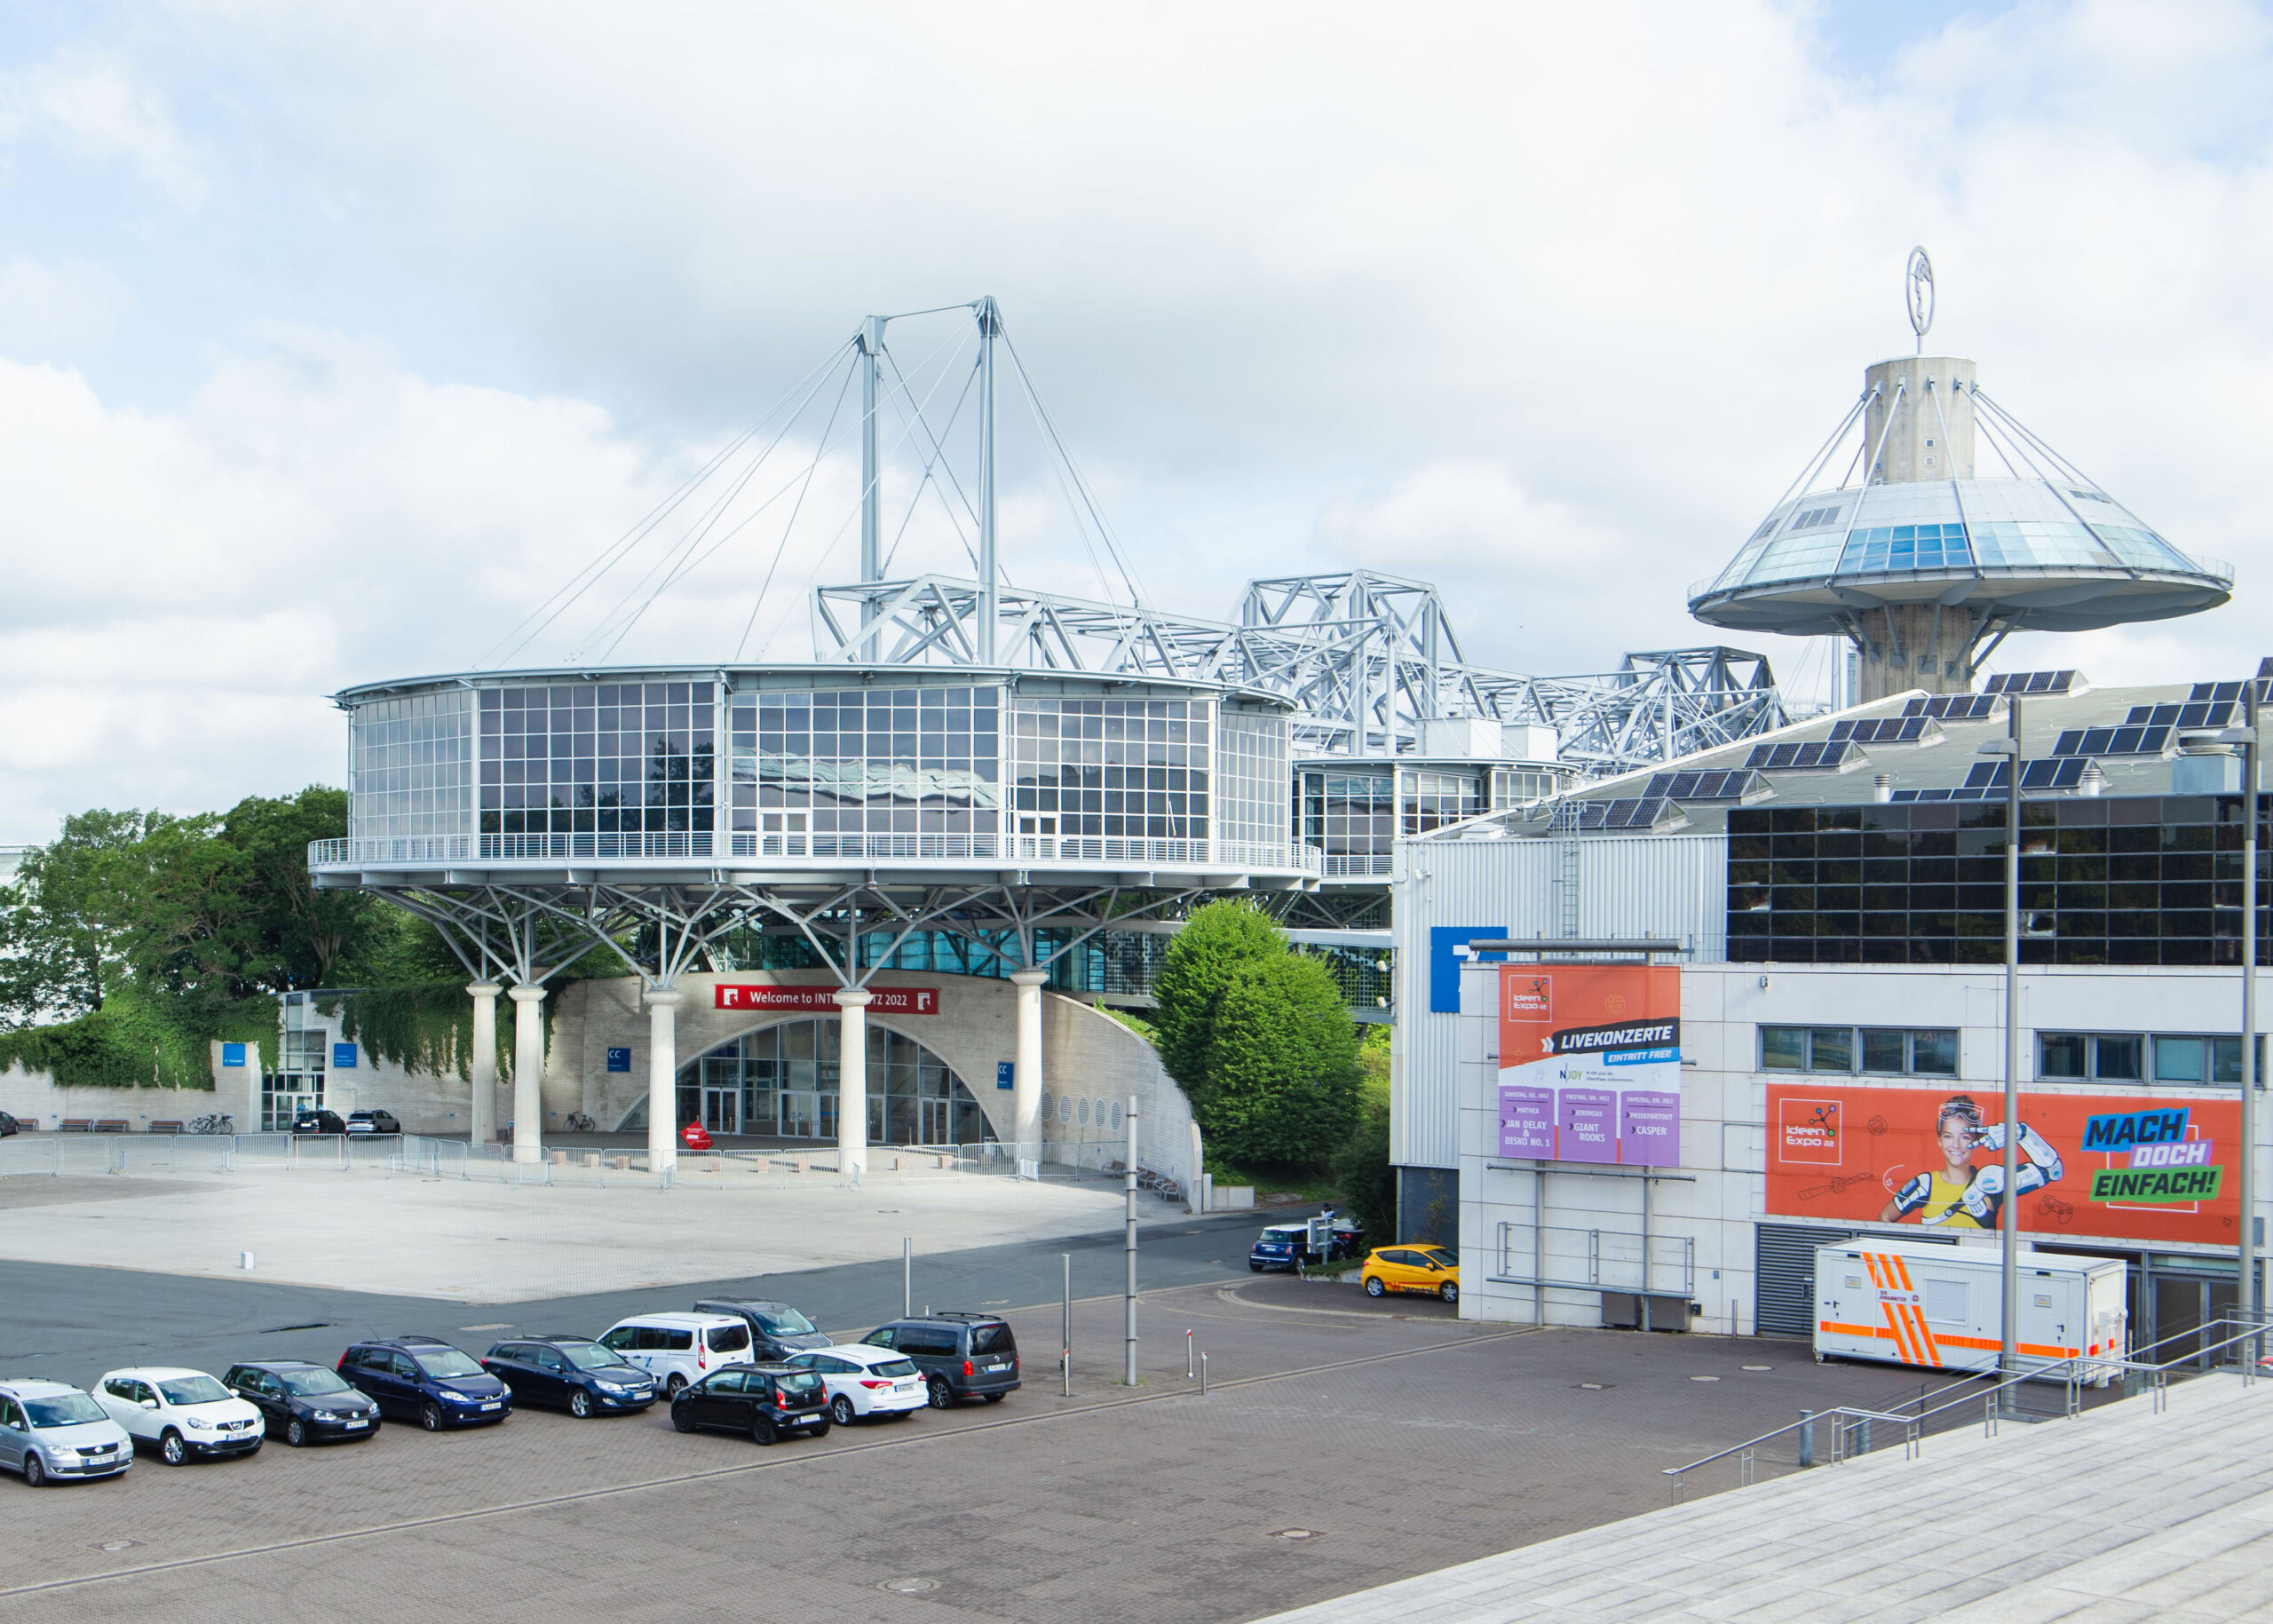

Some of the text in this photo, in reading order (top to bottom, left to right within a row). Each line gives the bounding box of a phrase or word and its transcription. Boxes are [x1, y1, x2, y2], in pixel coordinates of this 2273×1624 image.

[749, 991, 799, 1003] Welcome
[802, 993, 812, 1004] to
[885, 994, 907, 1006] 2022
[1513, 1002, 1539, 1010] Expo
[1560, 1026, 1674, 1050] LIVEKONZERTE
[1607, 1050, 1673, 1063] EINTRITT FREI!
[998, 1065, 1007, 1074] CC
[1505, 1120, 1547, 1129] JAN DELAY
[1573, 1122, 1599, 1131] GIANT
[2086, 1113, 2184, 1147] MACH
[1636, 1126, 1667, 1136] CASPER
[1786, 1125, 1826, 1136] Ideen
[1504, 1137, 1528, 1145] DISKO
[1579, 1132, 1605, 1142] ROOKS
[1786, 1136, 1822, 1147] Expo
[2133, 1143, 2207, 1167] DOCH
[2094, 1170, 2218, 1197] EINFACH!
